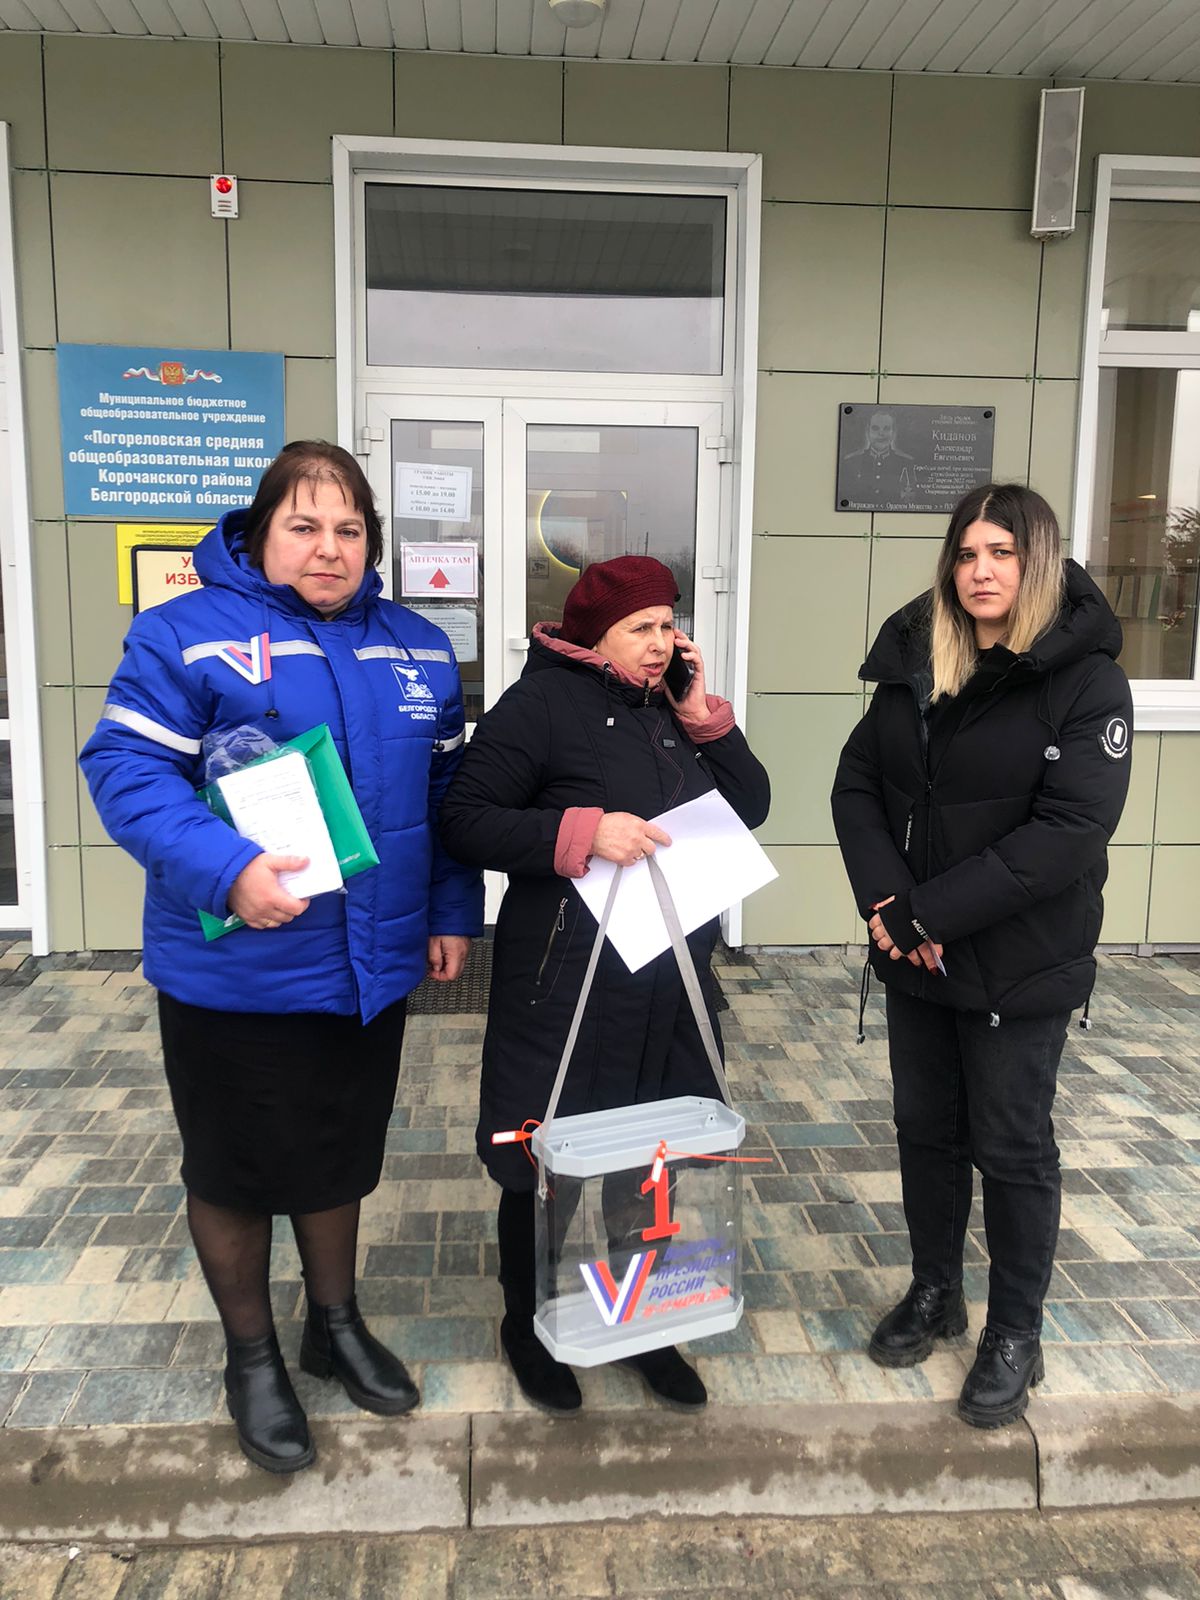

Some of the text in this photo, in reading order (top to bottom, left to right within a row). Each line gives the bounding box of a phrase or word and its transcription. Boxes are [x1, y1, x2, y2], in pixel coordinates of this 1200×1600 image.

[99, 392, 247, 408] Муниципальное бюджетное
[80, 406, 266, 423] общеобразовательное учреждение
[84, 430, 264, 450] «Погореловская средняя
[932, 430, 977, 441] Киданов
[934, 443, 973, 454] Александр
[69, 449, 230, 467] общеобразовательная
[98, 468, 253, 488] Корочанского района
[91, 487, 255, 506] Белгородской области
[181, 556, 191, 568] У
[410, 556, 471, 564] АПТЕЧКА ТАМ
[166, 572, 199, 585] ИЗБ
[640, 1166, 681, 1242] 1
[648, 1275, 707, 1301] РОССИИ
